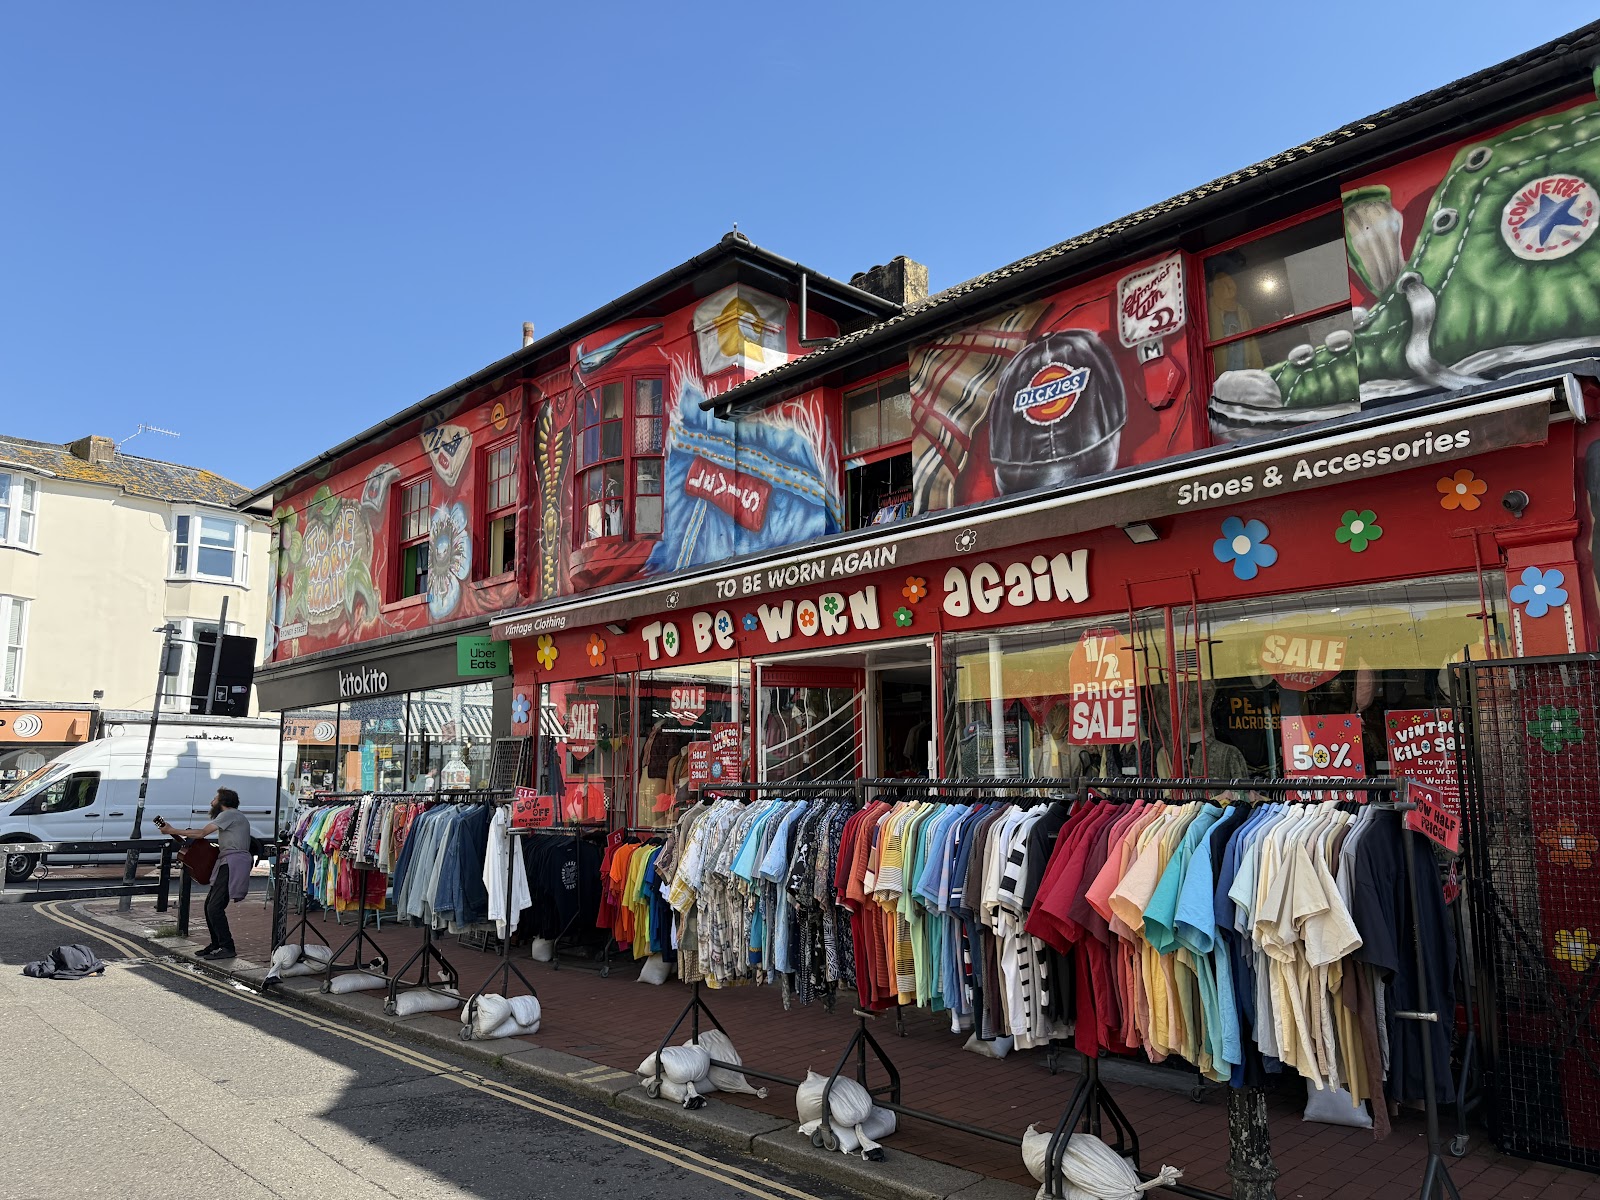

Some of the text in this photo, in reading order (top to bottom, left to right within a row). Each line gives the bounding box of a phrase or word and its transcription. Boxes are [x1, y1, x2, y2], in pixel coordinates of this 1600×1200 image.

[1508, 178, 1586, 226] CONVERSE
[1143, 341, 1161, 359] M
[1177, 429, 1471, 505] Shoes & Accessories
[716, 544, 897, 599] TO BE WORN AGAIN
[294, 624, 307, 634] STREET
[505, 615, 566, 636] Vintage Clothing
[641, 620, 680, 661] TO
[757, 585, 881, 643] WORN
[470, 648, 496, 658] Uber
[1262, 634, 1344, 671] SALE
[470, 660, 497, 669] Eats
[338, 665, 388, 697] kitokito
[1283, 671, 1319, 686] PRICE
[671, 688, 705, 710] SALE
[1073, 679, 1135, 701] PRICE
[569, 703, 598, 740] SALE
[1072, 699, 1137, 740] SALE
[1433, 736, 1466, 752] SaL
[1292, 742, 1353, 771] 50%
[1417, 758, 1444, 768] Every
[1404, 767, 1415, 775] at
[517, 797, 541, 813] 50%
[532, 808, 550, 817] OFF
